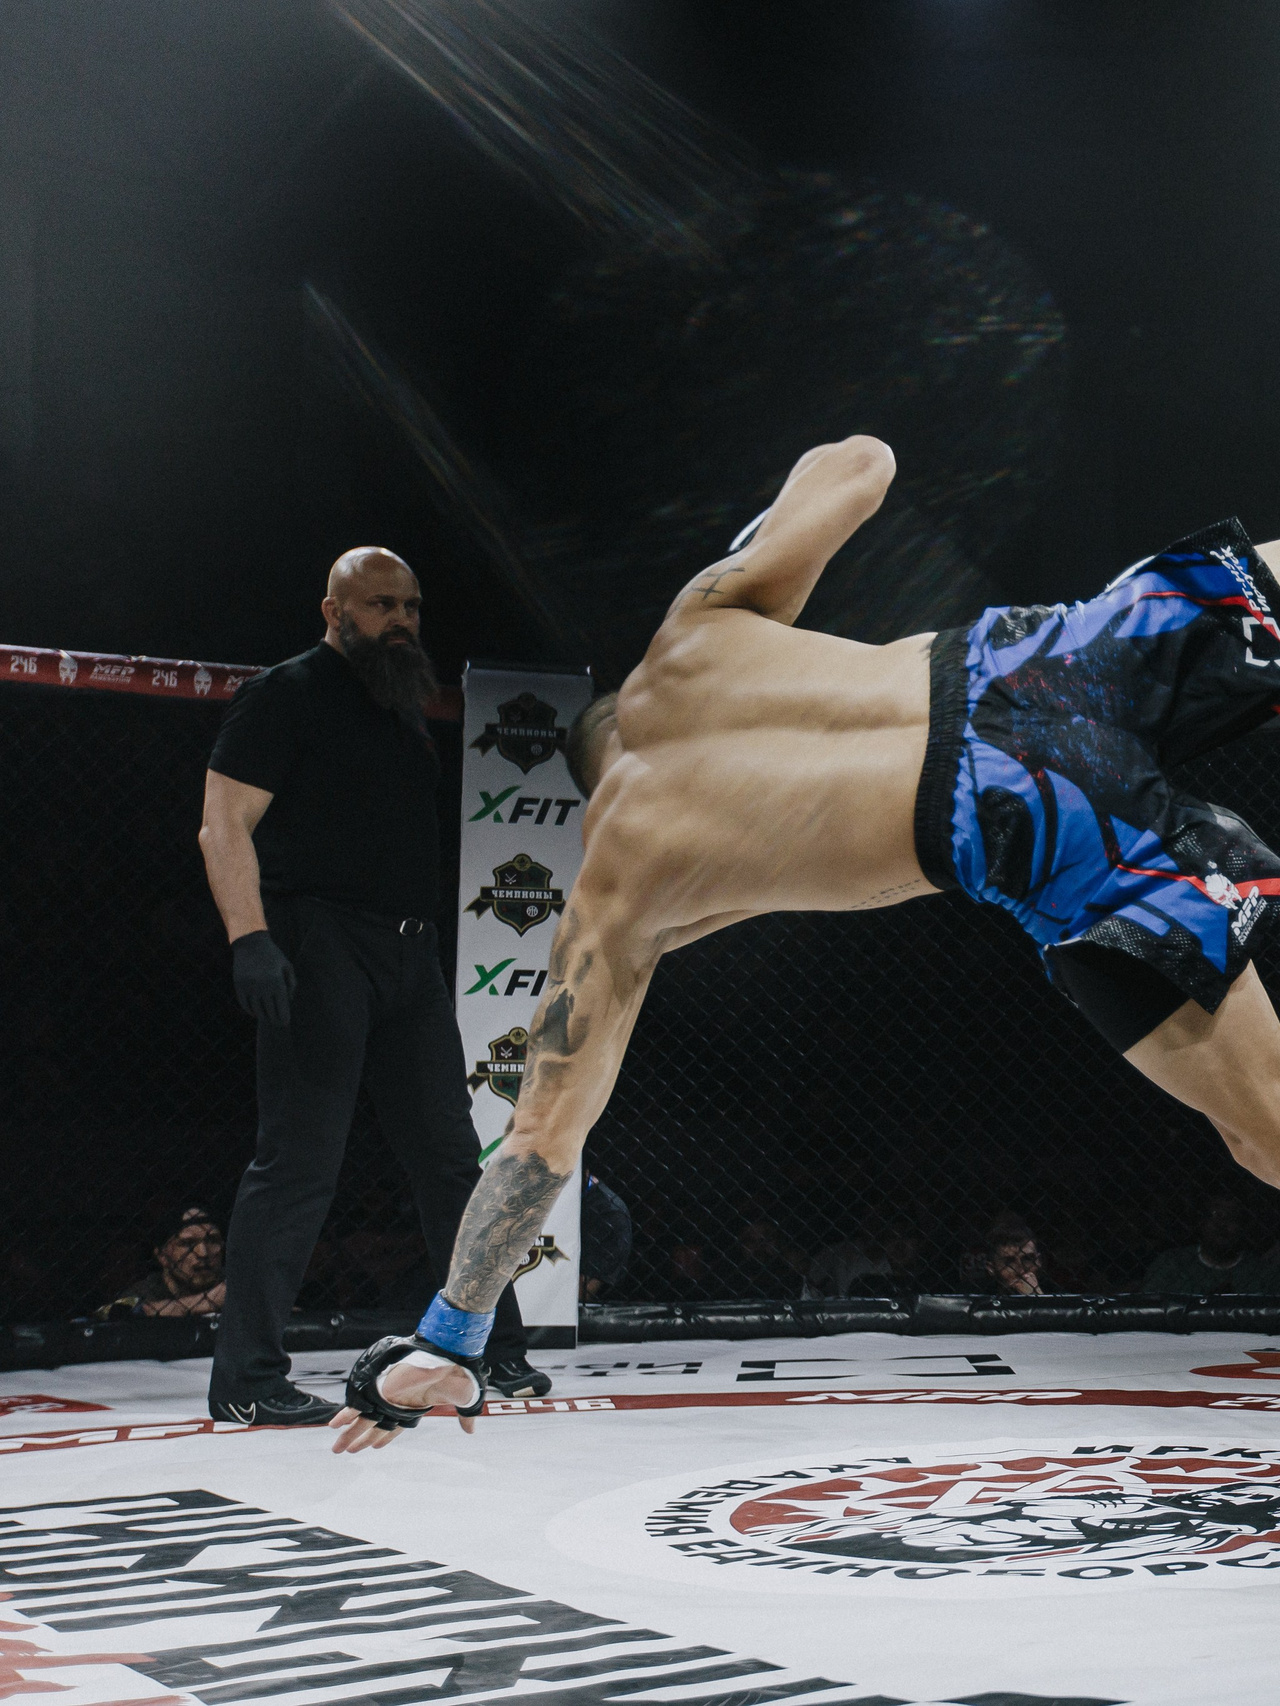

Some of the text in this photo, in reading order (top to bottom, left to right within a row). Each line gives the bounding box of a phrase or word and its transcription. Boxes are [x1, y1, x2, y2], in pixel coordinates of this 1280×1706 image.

[10, 655, 37, 674] 246
[93, 663, 135, 677] MFP
[152, 668, 178, 688] 246
[467, 784, 581, 826] XFIT
[1231, 886, 1259, 936] MFP
[463, 957, 549, 997] XFI
[487, 1063, 526, 1073] ЧЕМПИ
[487, 1397, 616, 1415] 246
[644, 1457, 916, 1539] АКАДЕМИЯ
